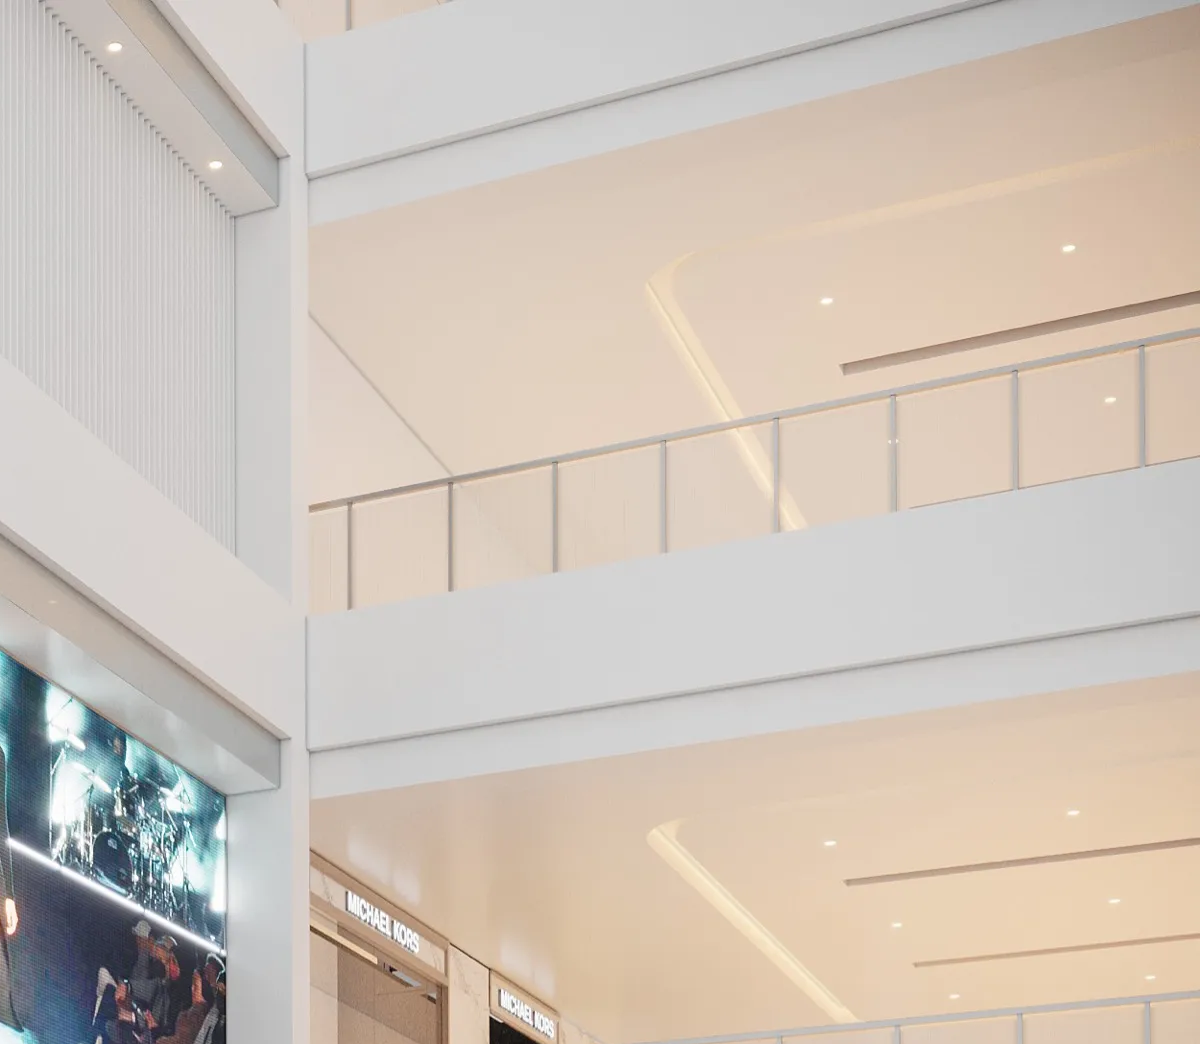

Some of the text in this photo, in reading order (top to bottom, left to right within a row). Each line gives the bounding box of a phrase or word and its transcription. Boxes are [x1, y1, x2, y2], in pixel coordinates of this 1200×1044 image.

[346, 890, 420, 954] MICHAEL KORS
[498, 988, 555, 1039] MICHAEL KORS
